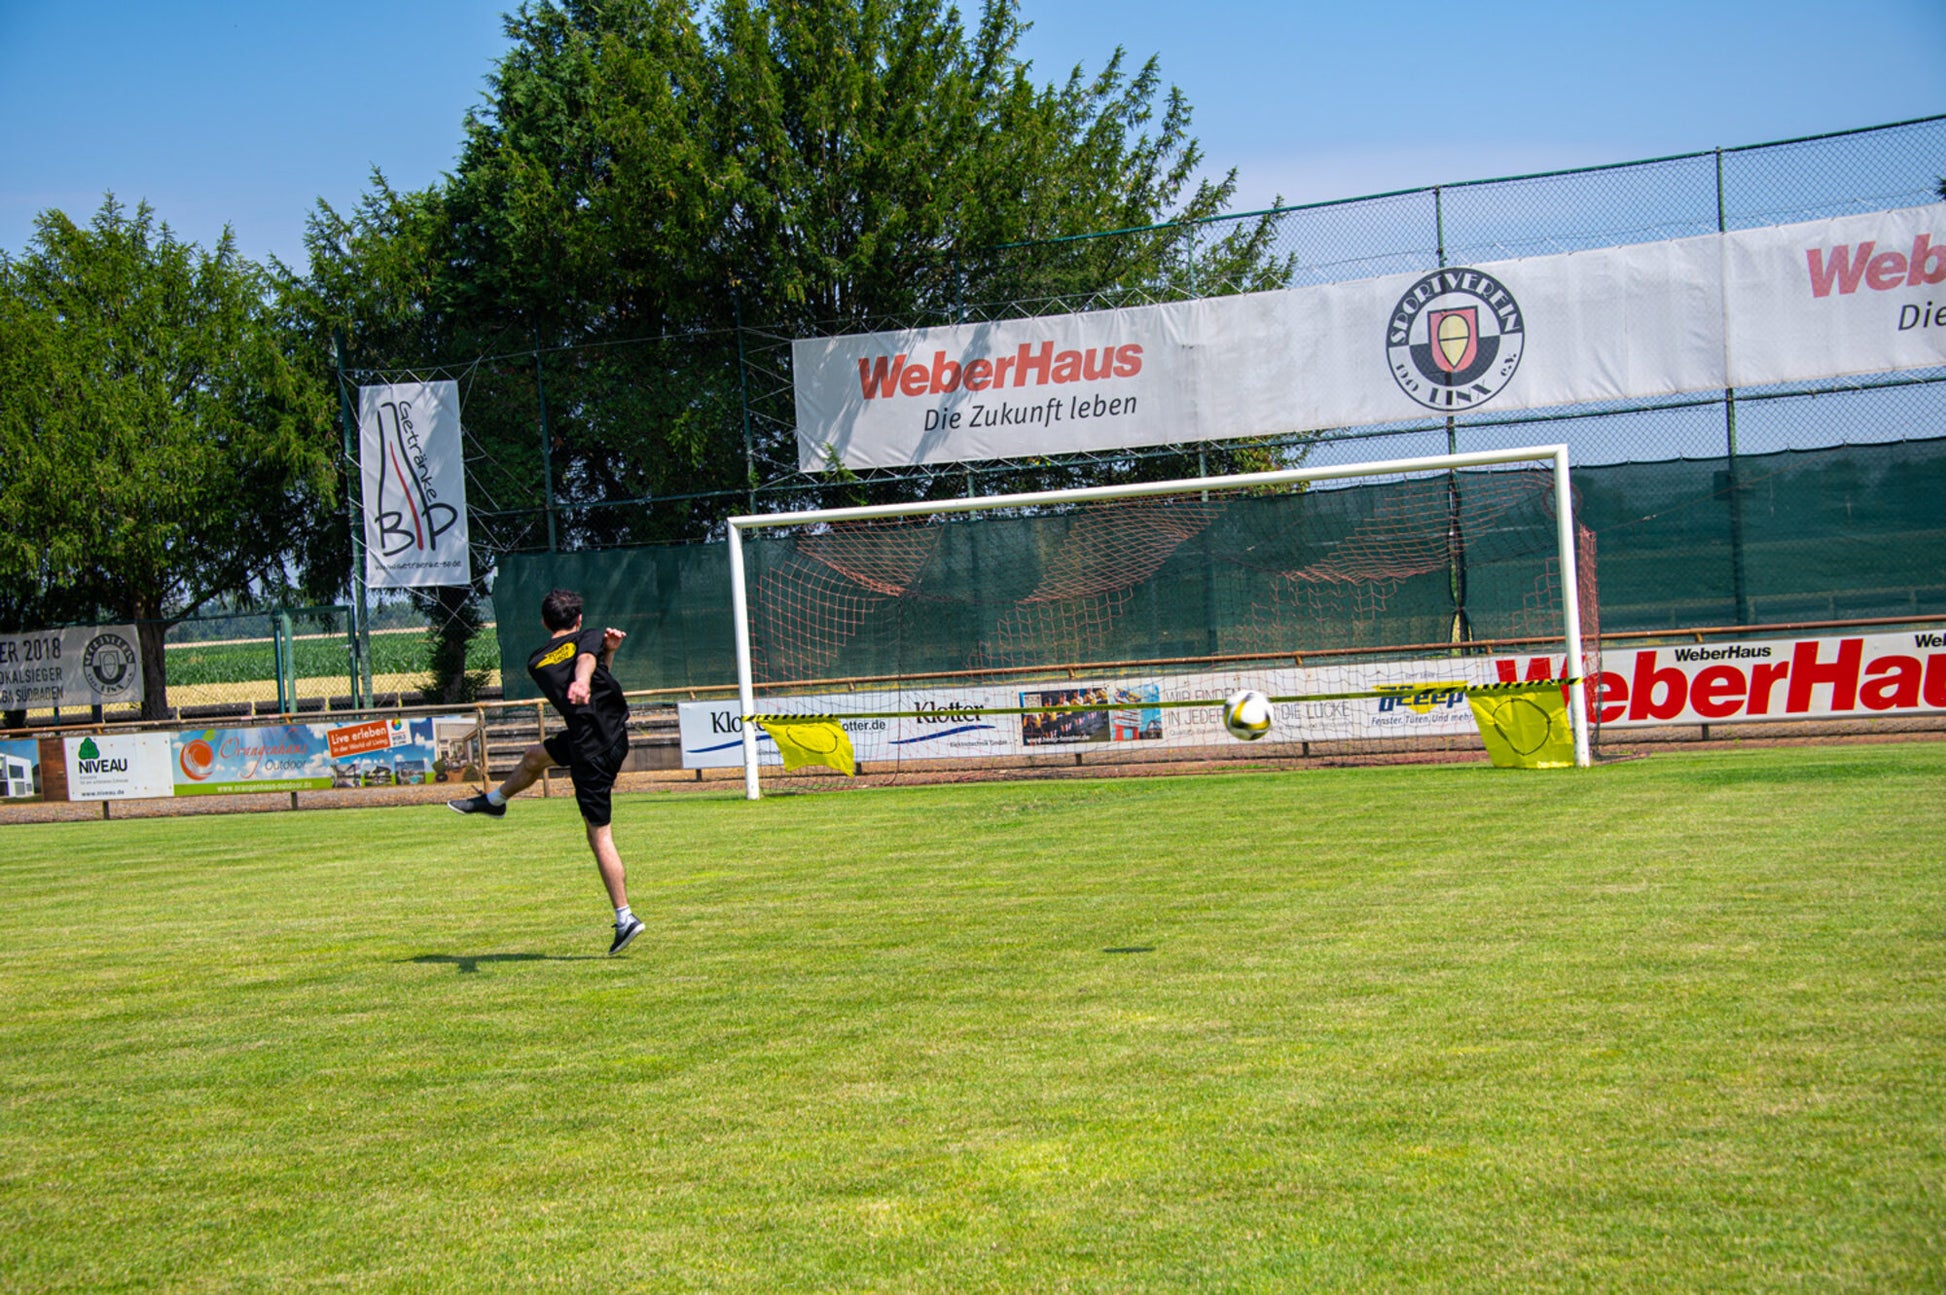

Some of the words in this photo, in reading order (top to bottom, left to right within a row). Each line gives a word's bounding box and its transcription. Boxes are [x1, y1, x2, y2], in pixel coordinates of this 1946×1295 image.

[1390, 272, 1520, 344] SPORTVEREIN
[1898, 301, 1946, 331] Die
[858, 341, 1143, 400] WeberHaus
[1429, 379, 1493, 406] LINX
[924, 408, 961, 431] Die
[969, 397, 1063, 428] Zukunft
[1070, 394, 1137, 421] leben
[398, 400, 438, 503] Getränke
[23, 637, 61, 661] 2018
[1915, 632, 1946, 648] We
[1675, 645, 1771, 662] WeberHaus
[915, 701, 984, 724] Klotter
[1168, 710, 1180, 726] IN
[1281, 703, 1300, 720] DIE
[331, 734, 349, 746] Live
[352, 726, 387, 740] erleben
[79, 758, 128, 774] NIVEAU
[264, 759, 306, 771] Outdoor
